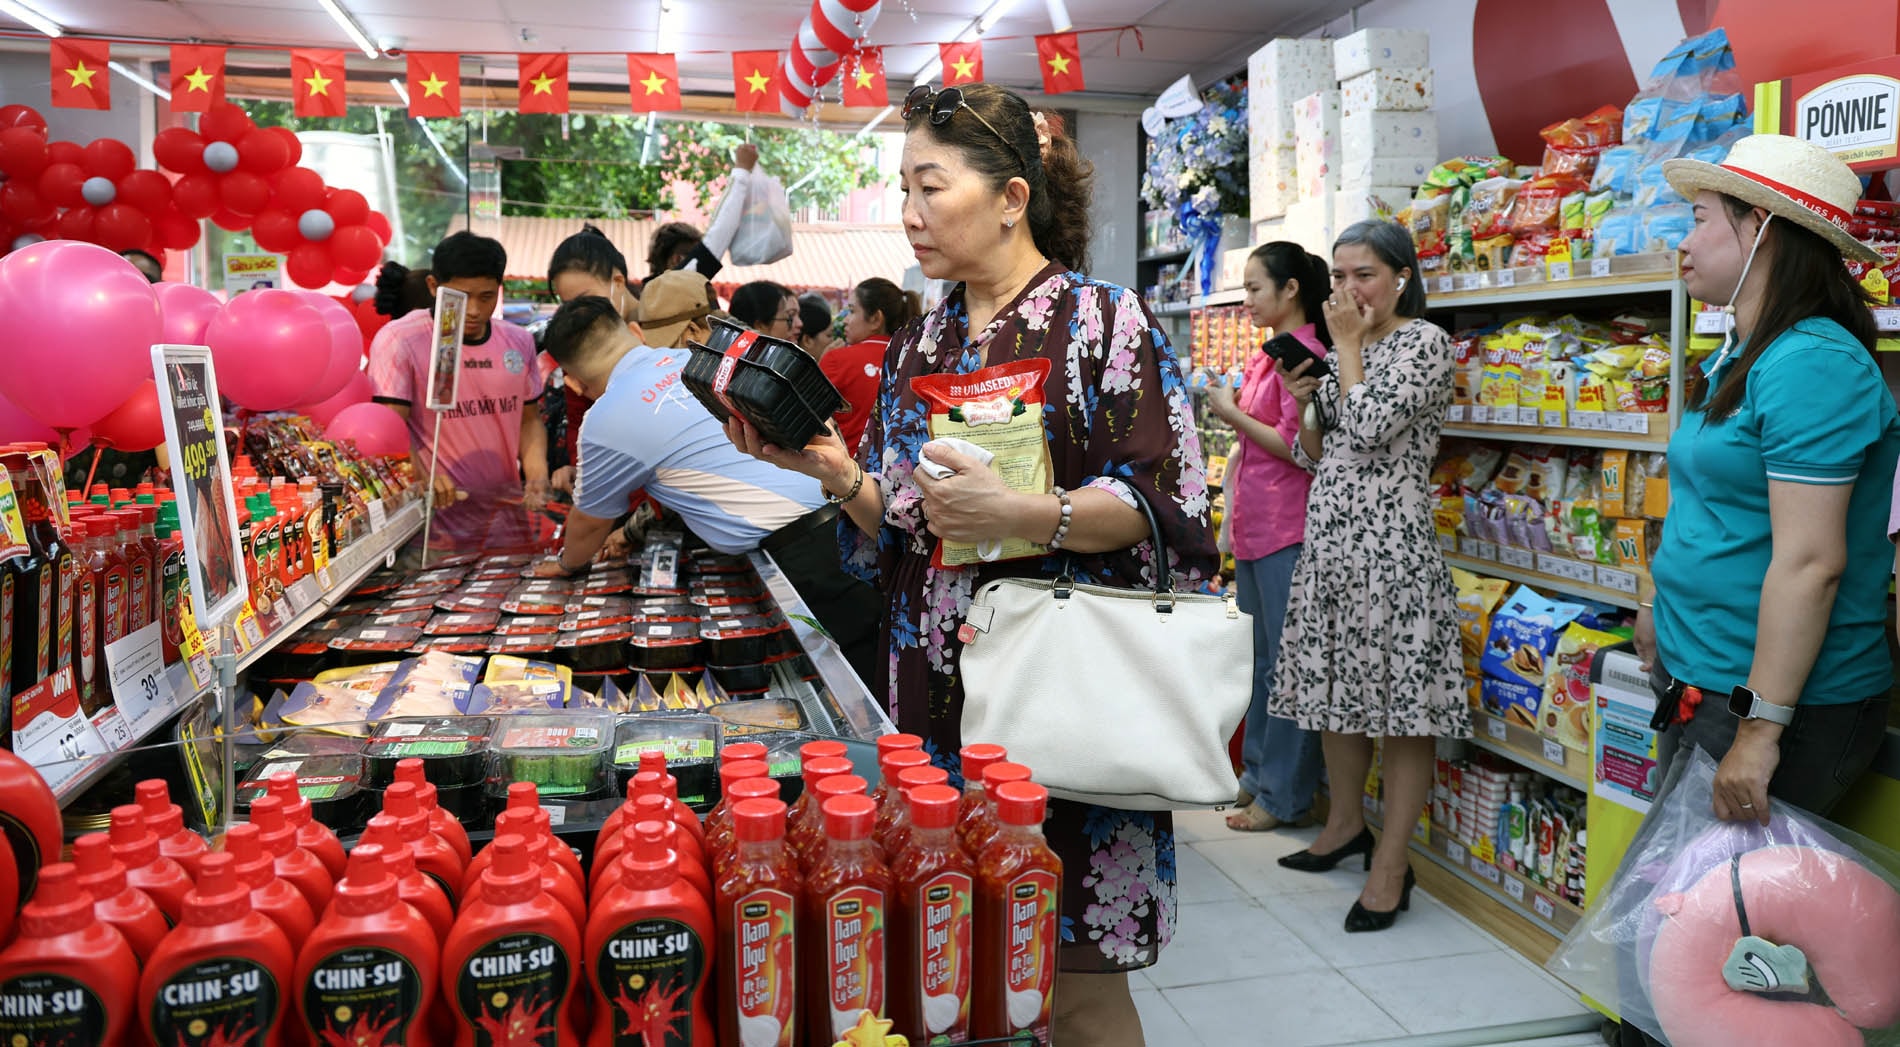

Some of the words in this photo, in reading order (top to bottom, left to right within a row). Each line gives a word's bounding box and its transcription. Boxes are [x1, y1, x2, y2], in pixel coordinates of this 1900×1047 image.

[1806, 93, 1889, 140] PÖNNIE
[963, 376, 1011, 396] VINASEED
[443, 401, 478, 419] HANG
[141, 673, 159, 701] 39
[114, 725, 127, 741] 25
[927, 903, 952, 929] Nam
[1012, 900, 1037, 925] Nam
[742, 921, 770, 945] Nam
[835, 918, 862, 942] Nam
[608, 931, 689, 959] CHIN-SU
[469, 944, 555, 978] CHIN-SU
[163, 969, 260, 1006] CHIN-SU
[314, 960, 402, 990] CHIN-SU
